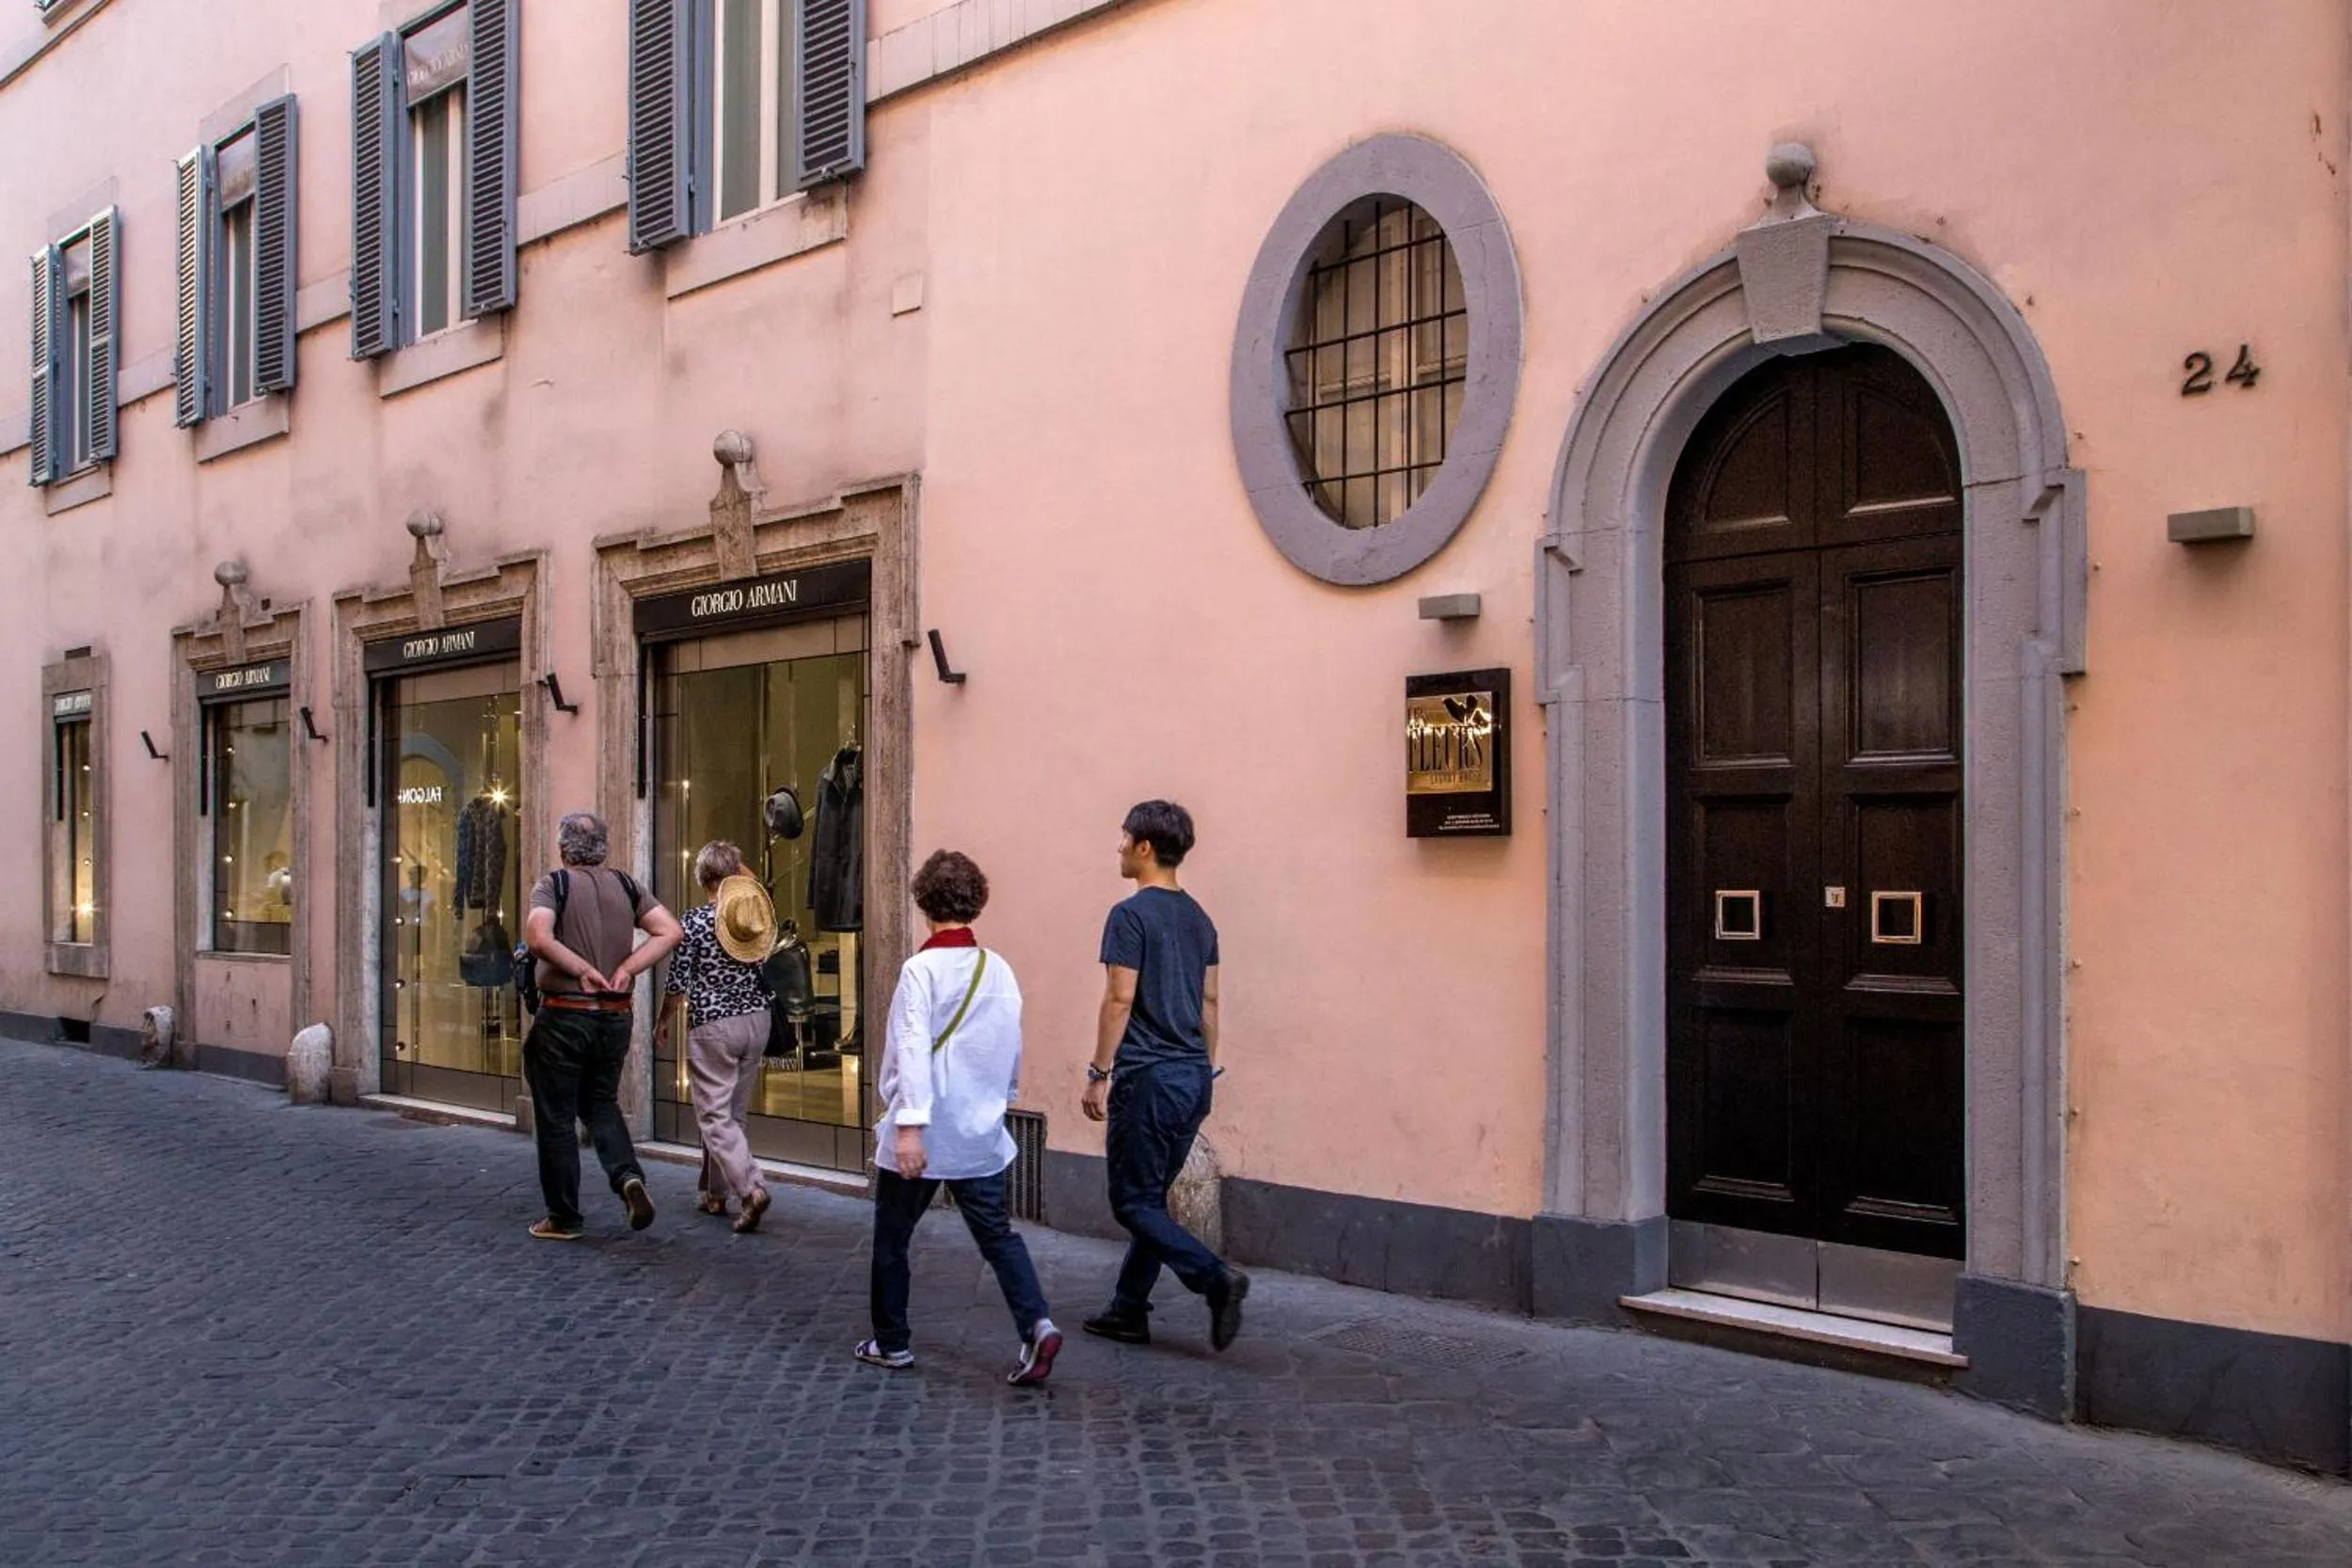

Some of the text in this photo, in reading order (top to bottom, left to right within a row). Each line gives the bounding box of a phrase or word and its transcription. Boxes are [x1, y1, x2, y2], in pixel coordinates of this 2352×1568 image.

[2181, 344, 2261, 396] 24
[691, 579, 798, 617] GIORGIO ARMANI
[441, 630, 474, 653] ARMANI
